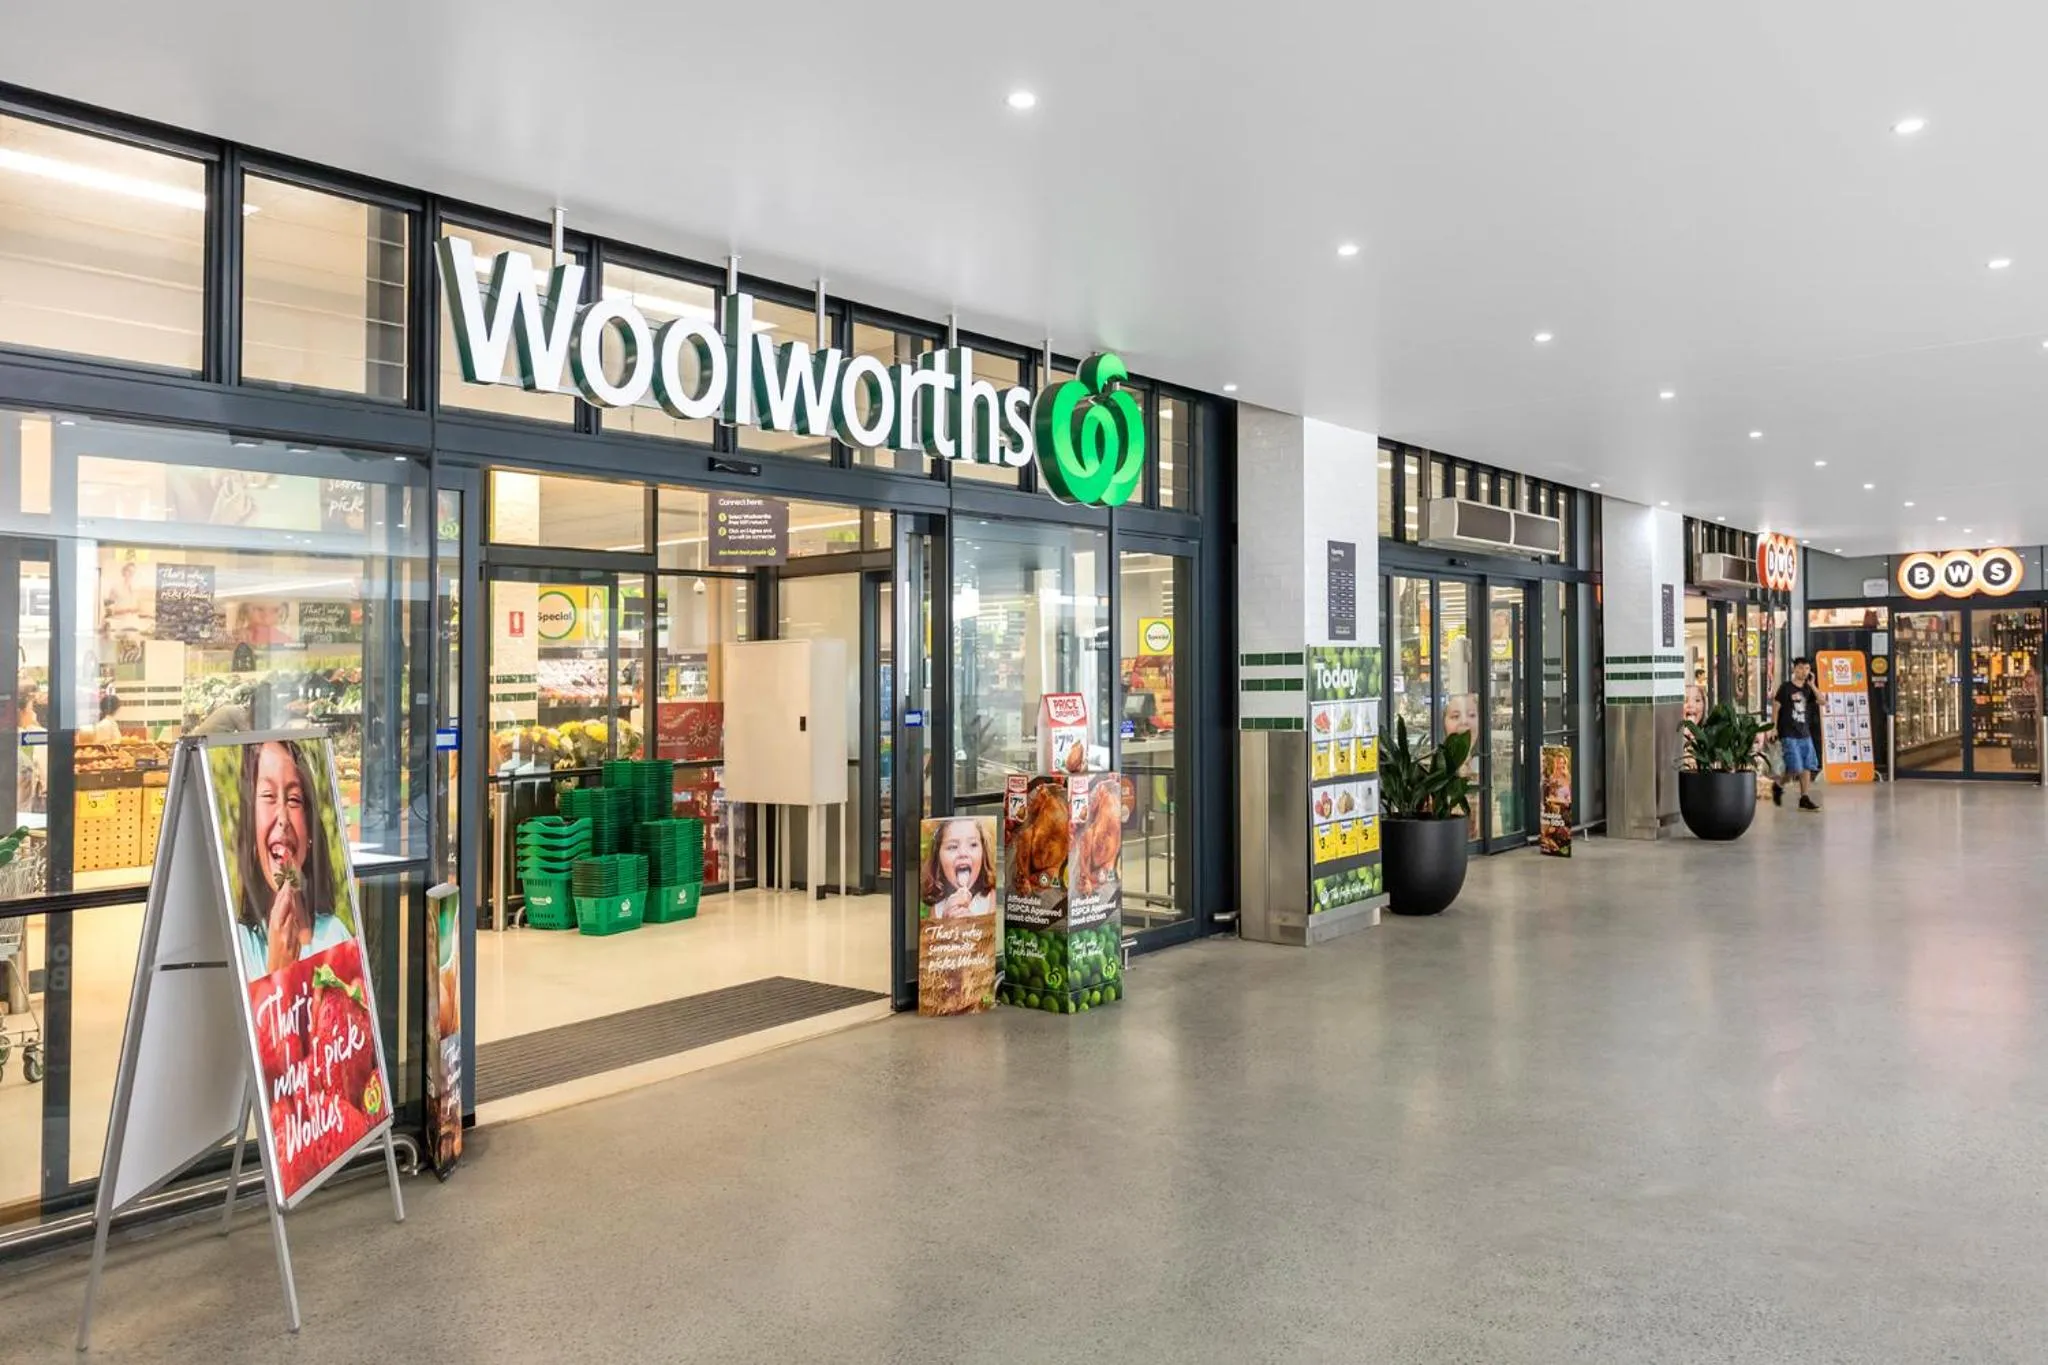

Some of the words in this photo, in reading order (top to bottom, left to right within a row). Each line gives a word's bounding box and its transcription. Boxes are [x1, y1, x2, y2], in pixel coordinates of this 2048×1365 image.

[436, 236, 1035, 468] Woolworths
[1914, 562, 2005, 585] BWS
[1313, 662, 1358, 696] Today
[1053, 698, 1079, 710] PRICE
[1007, 903, 1030, 914] RSPCA
[1030, 906, 1063, 918] Approved
[1025, 915, 1050, 925] chicken
[925, 924, 959, 941] That's
[962, 923, 983, 941] why
[928, 955, 956, 973] picks
[257, 981, 313, 1048] That's
[274, 1041, 309, 1107] why
[312, 1036, 321, 1077] I
[325, 1013, 365, 1087] pick
[285, 1091, 344, 1164] Woolies
